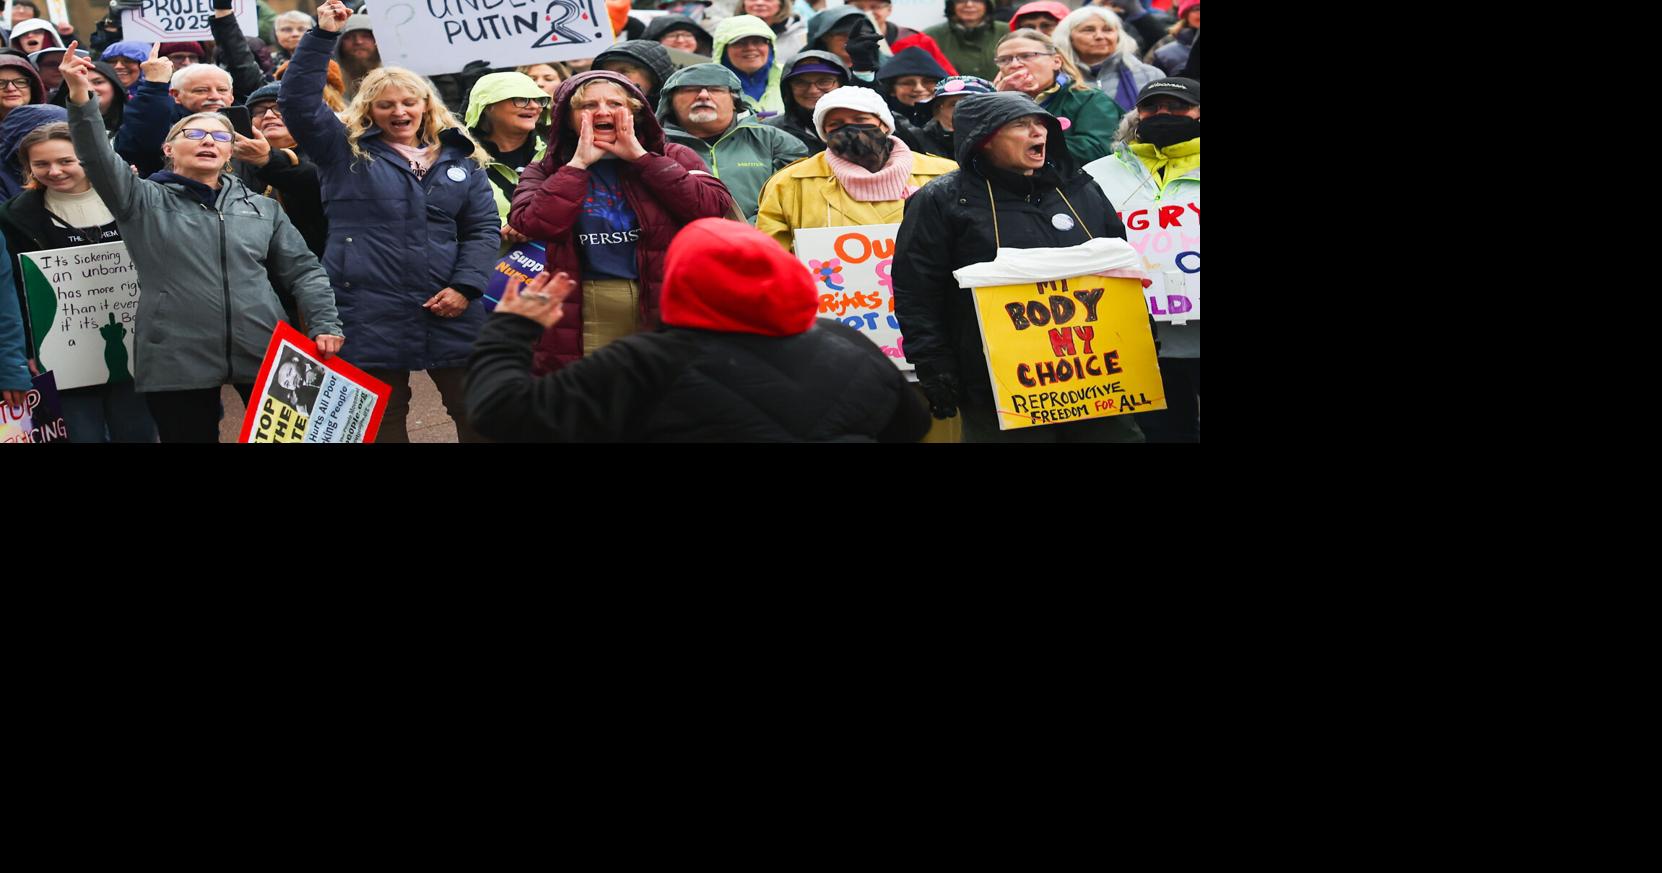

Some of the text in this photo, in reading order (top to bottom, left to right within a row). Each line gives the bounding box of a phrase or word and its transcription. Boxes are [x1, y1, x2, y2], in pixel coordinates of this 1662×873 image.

[160, 14, 209, 31] 2025
[444, 11, 538, 44] PUTIN
[52, 271, 72, 283] an
[82, 264, 127, 278] unborn
[509, 250, 545, 273] Supp
[57, 287, 81, 300] has
[87, 286, 114, 296] more
[62, 302, 96, 316] than
[100, 299, 109, 310] it
[61, 317, 72, 332] if
[80, 316, 99, 329] it's
[835, 312, 879, 331] OT
[1005, 288, 1105, 331] BODY
[68, 338, 76, 347] a
[1048, 325, 1095, 357] MY
[1017, 350, 1123, 388] CHOICE
[309, 375, 338, 442] Hurts All Poor
[331, 385, 348, 418] People
[1011, 381, 1125, 413] REPRODUCTIVE
[1030, 393, 1152, 424] FREEDOM FOR ALL
[254, 397, 275, 443] TOP
